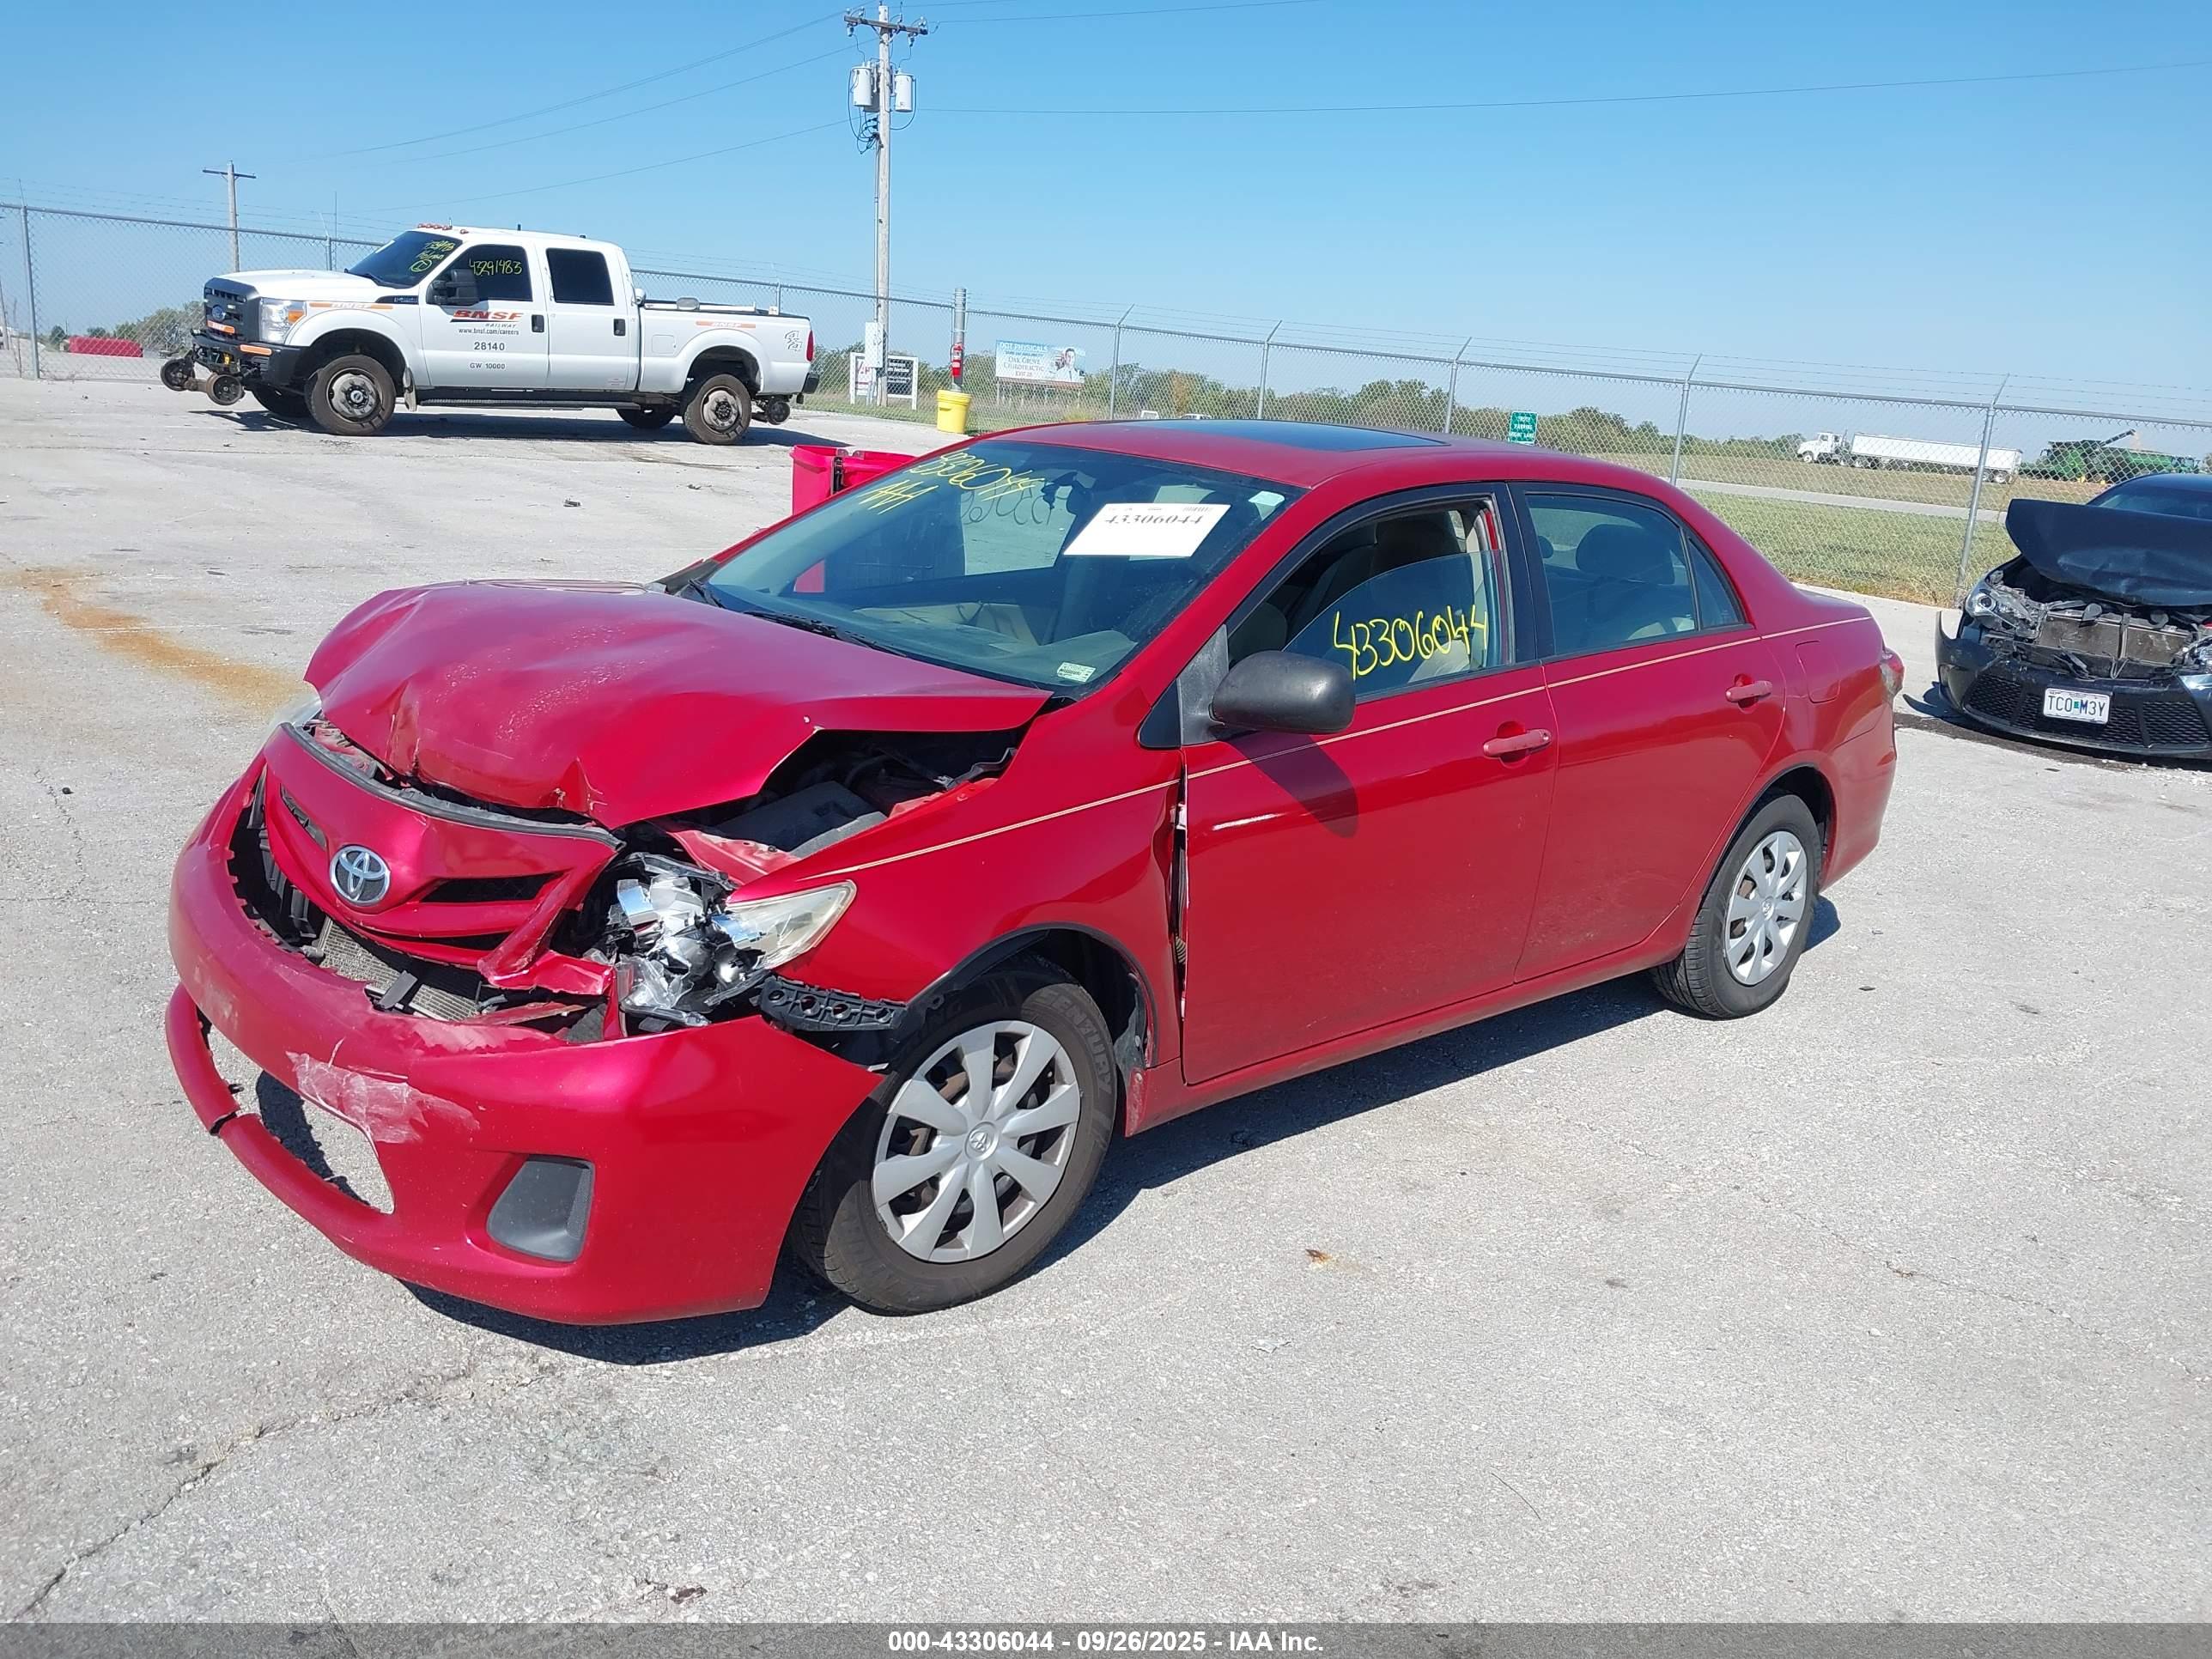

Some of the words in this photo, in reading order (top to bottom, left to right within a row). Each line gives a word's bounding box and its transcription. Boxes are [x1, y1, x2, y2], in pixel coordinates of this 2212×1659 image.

[469, 258, 523, 276] 43291483
[453, 310, 524, 319] BNSF
[474, 342, 505, 350] 28140
[1014, 343, 1048, 352] PHYSICALS
[1105, 514, 1203, 524] 43306044
[1334, 605, 1488, 681] 43306044
[2080, 699, 2106, 716] M3Y
